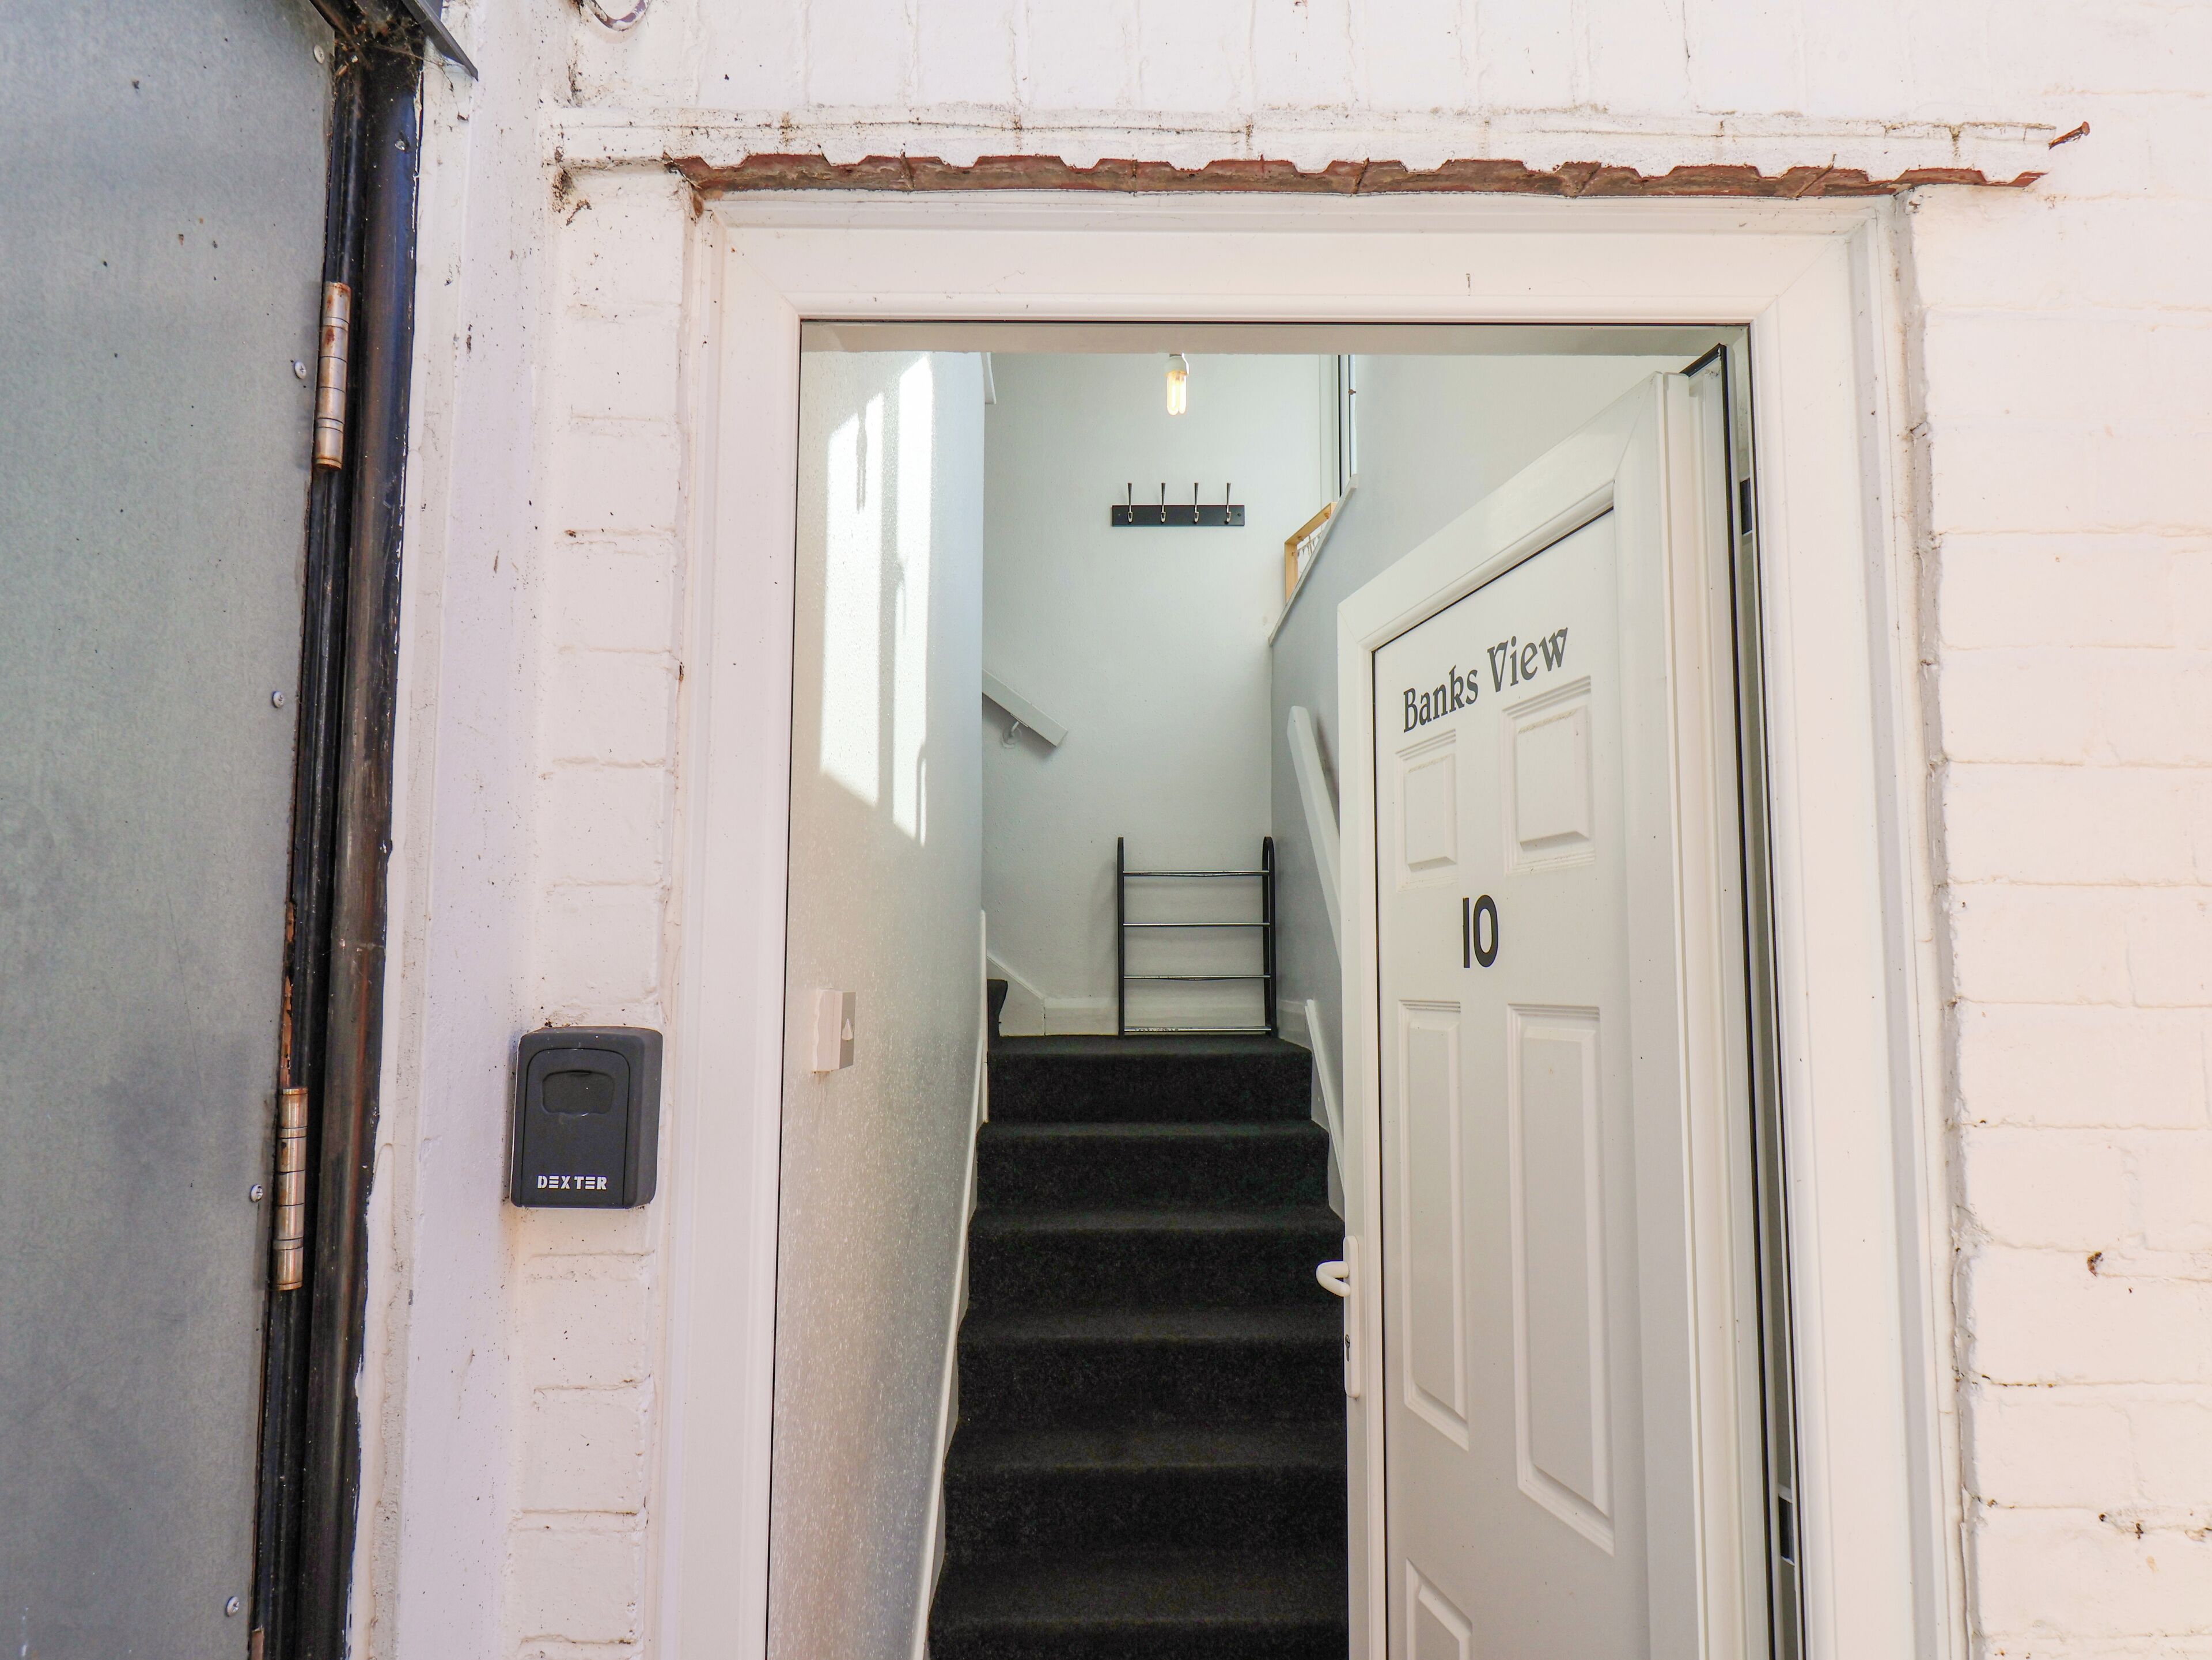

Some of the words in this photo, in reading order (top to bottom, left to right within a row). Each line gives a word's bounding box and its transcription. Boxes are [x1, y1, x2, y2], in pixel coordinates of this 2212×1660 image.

[1403, 665, 1478, 733] Banks
[1487, 627, 1568, 692] View
[1463, 895, 1498, 968] 10
[537, 1175, 607, 1190] DEXTER
